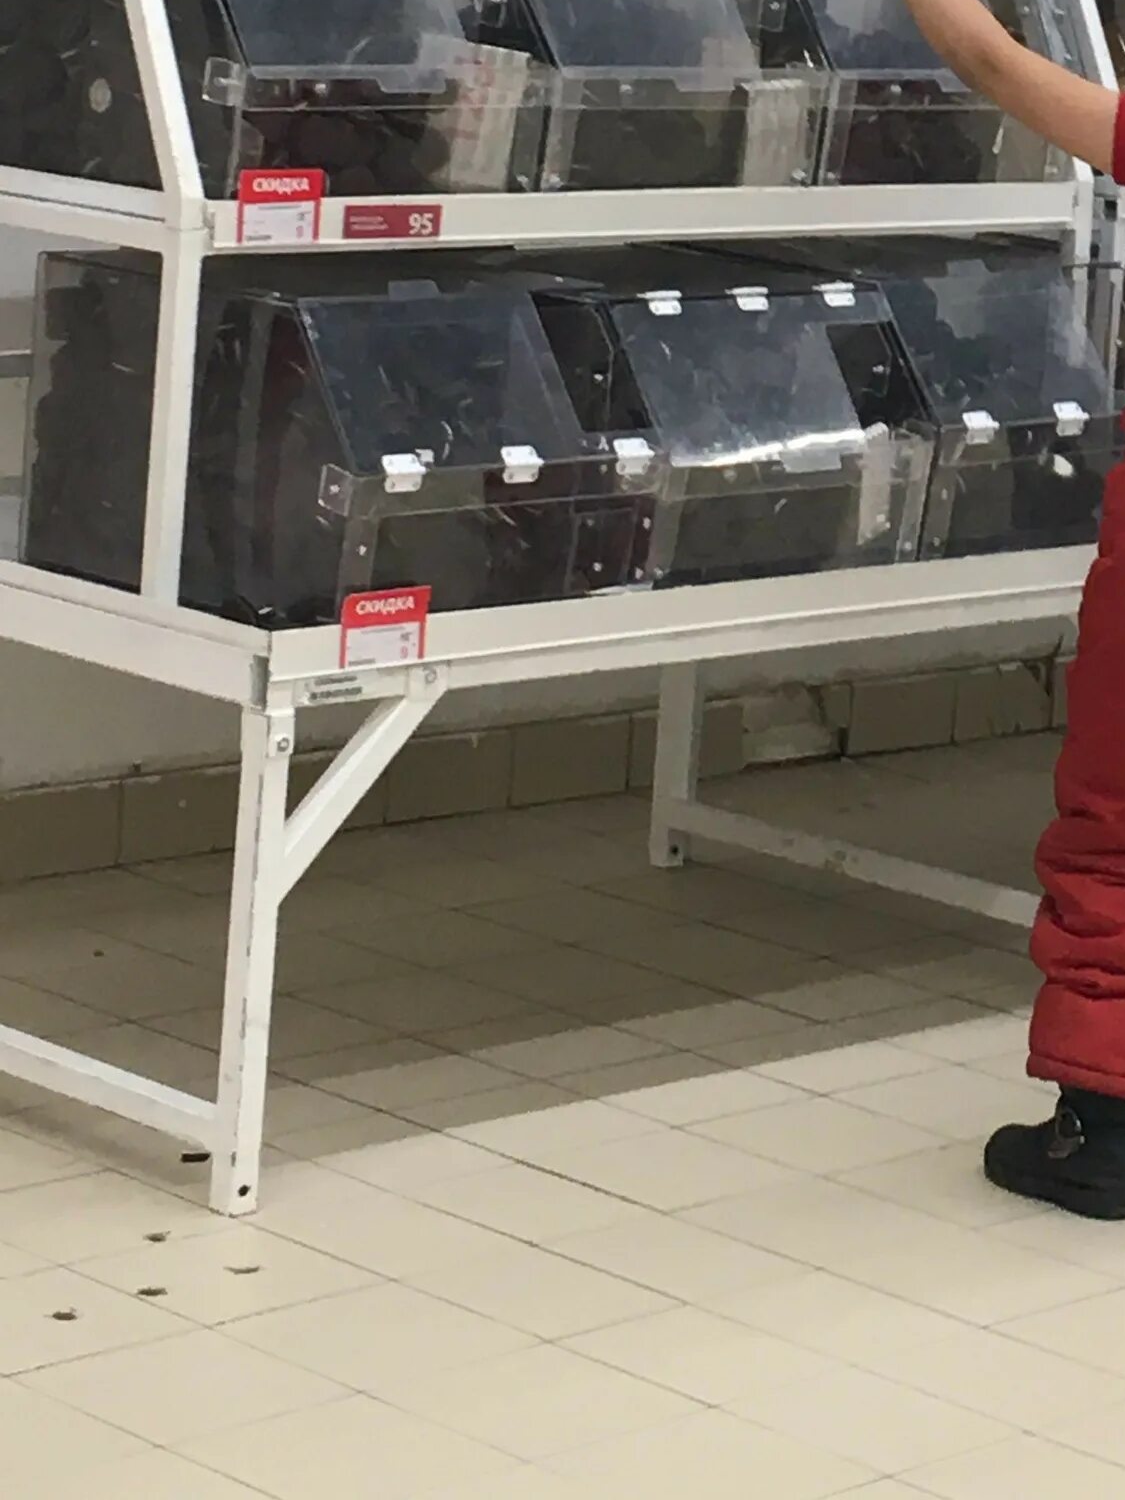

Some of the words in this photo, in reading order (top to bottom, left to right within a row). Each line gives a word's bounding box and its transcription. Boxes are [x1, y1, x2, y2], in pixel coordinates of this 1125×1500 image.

[252, 177, 310, 196] СКИДКА
[407, 212, 434, 236] 95
[355, 596, 416, 616] СКИДКА
